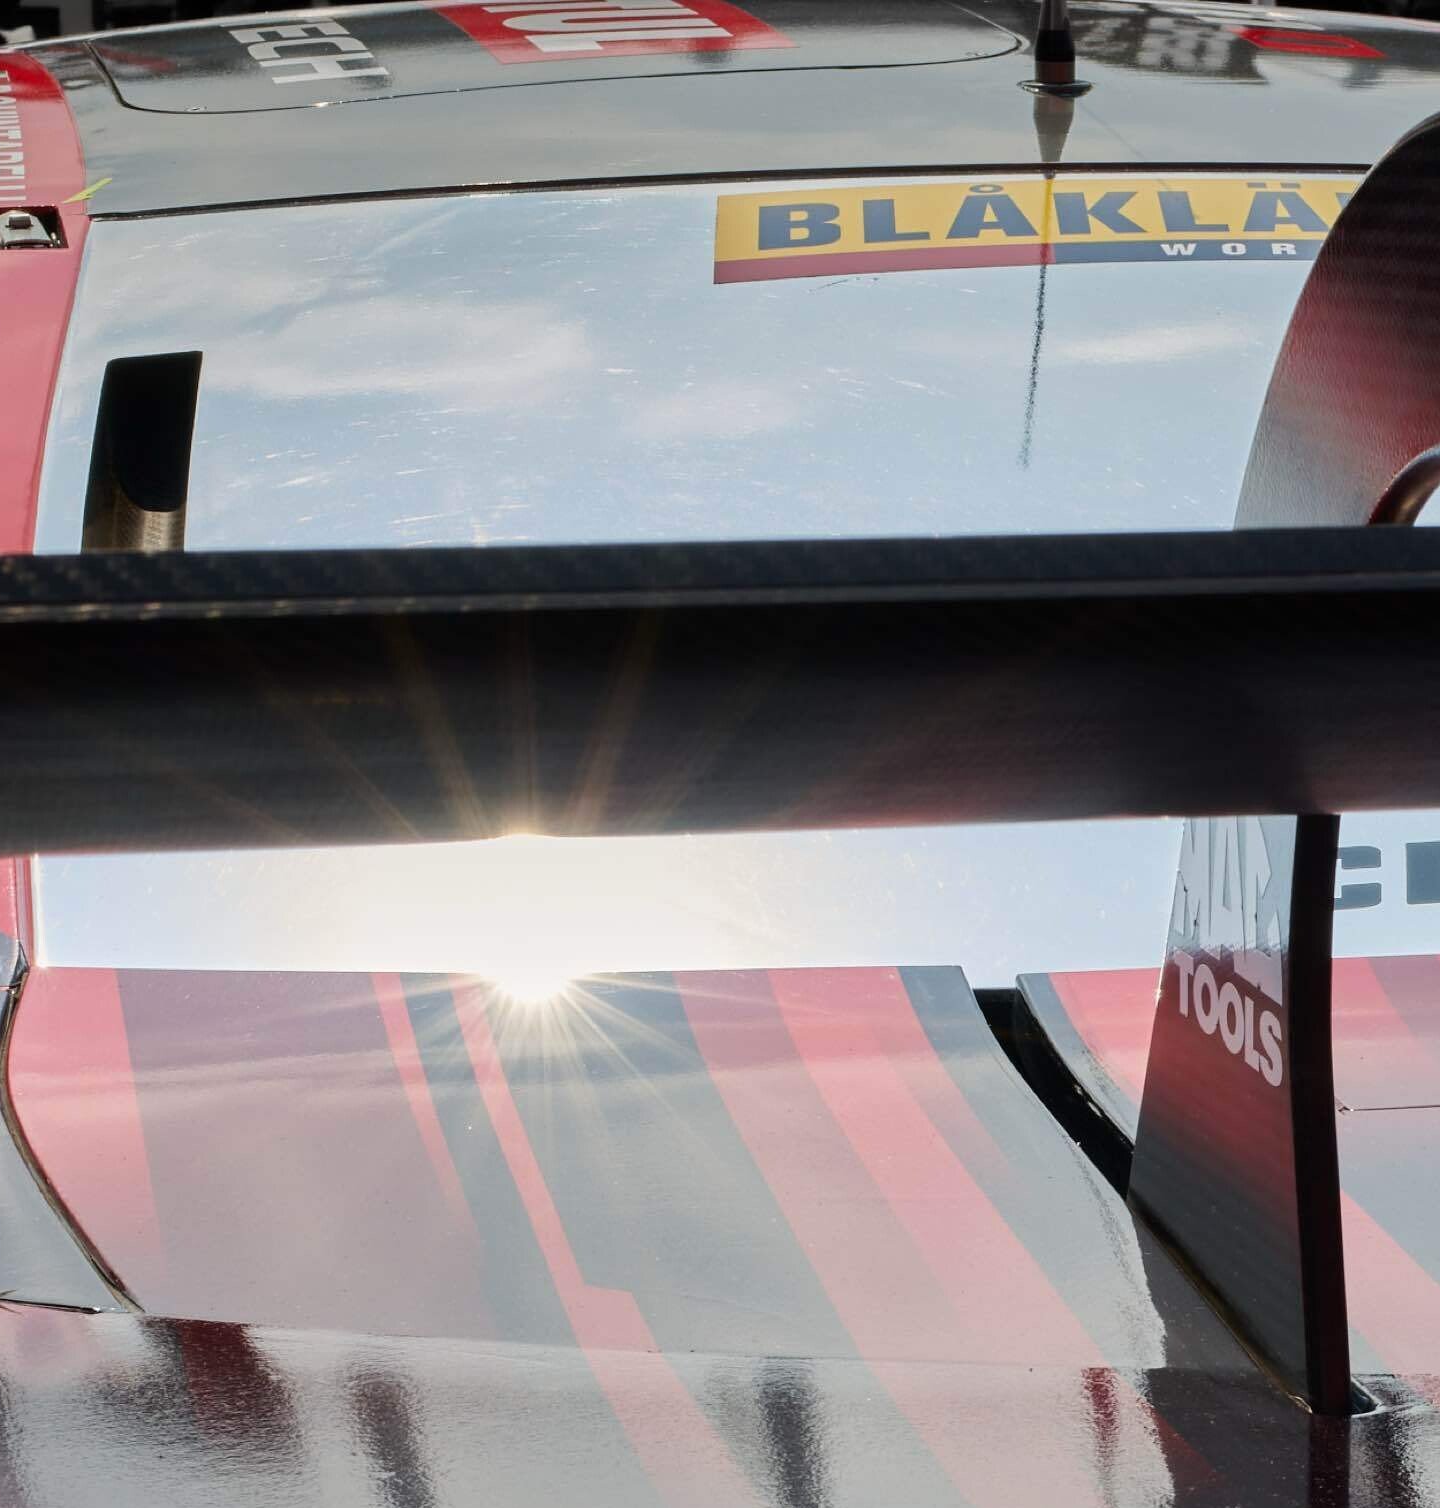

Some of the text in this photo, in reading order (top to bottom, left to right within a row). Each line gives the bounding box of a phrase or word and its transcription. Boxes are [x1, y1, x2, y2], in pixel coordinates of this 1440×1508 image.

[759, 182, 1356, 250] BLÅKLÄ
[1160, 243, 1298, 256] WOR
[1172, 947, 1283, 1087] TOOLS
